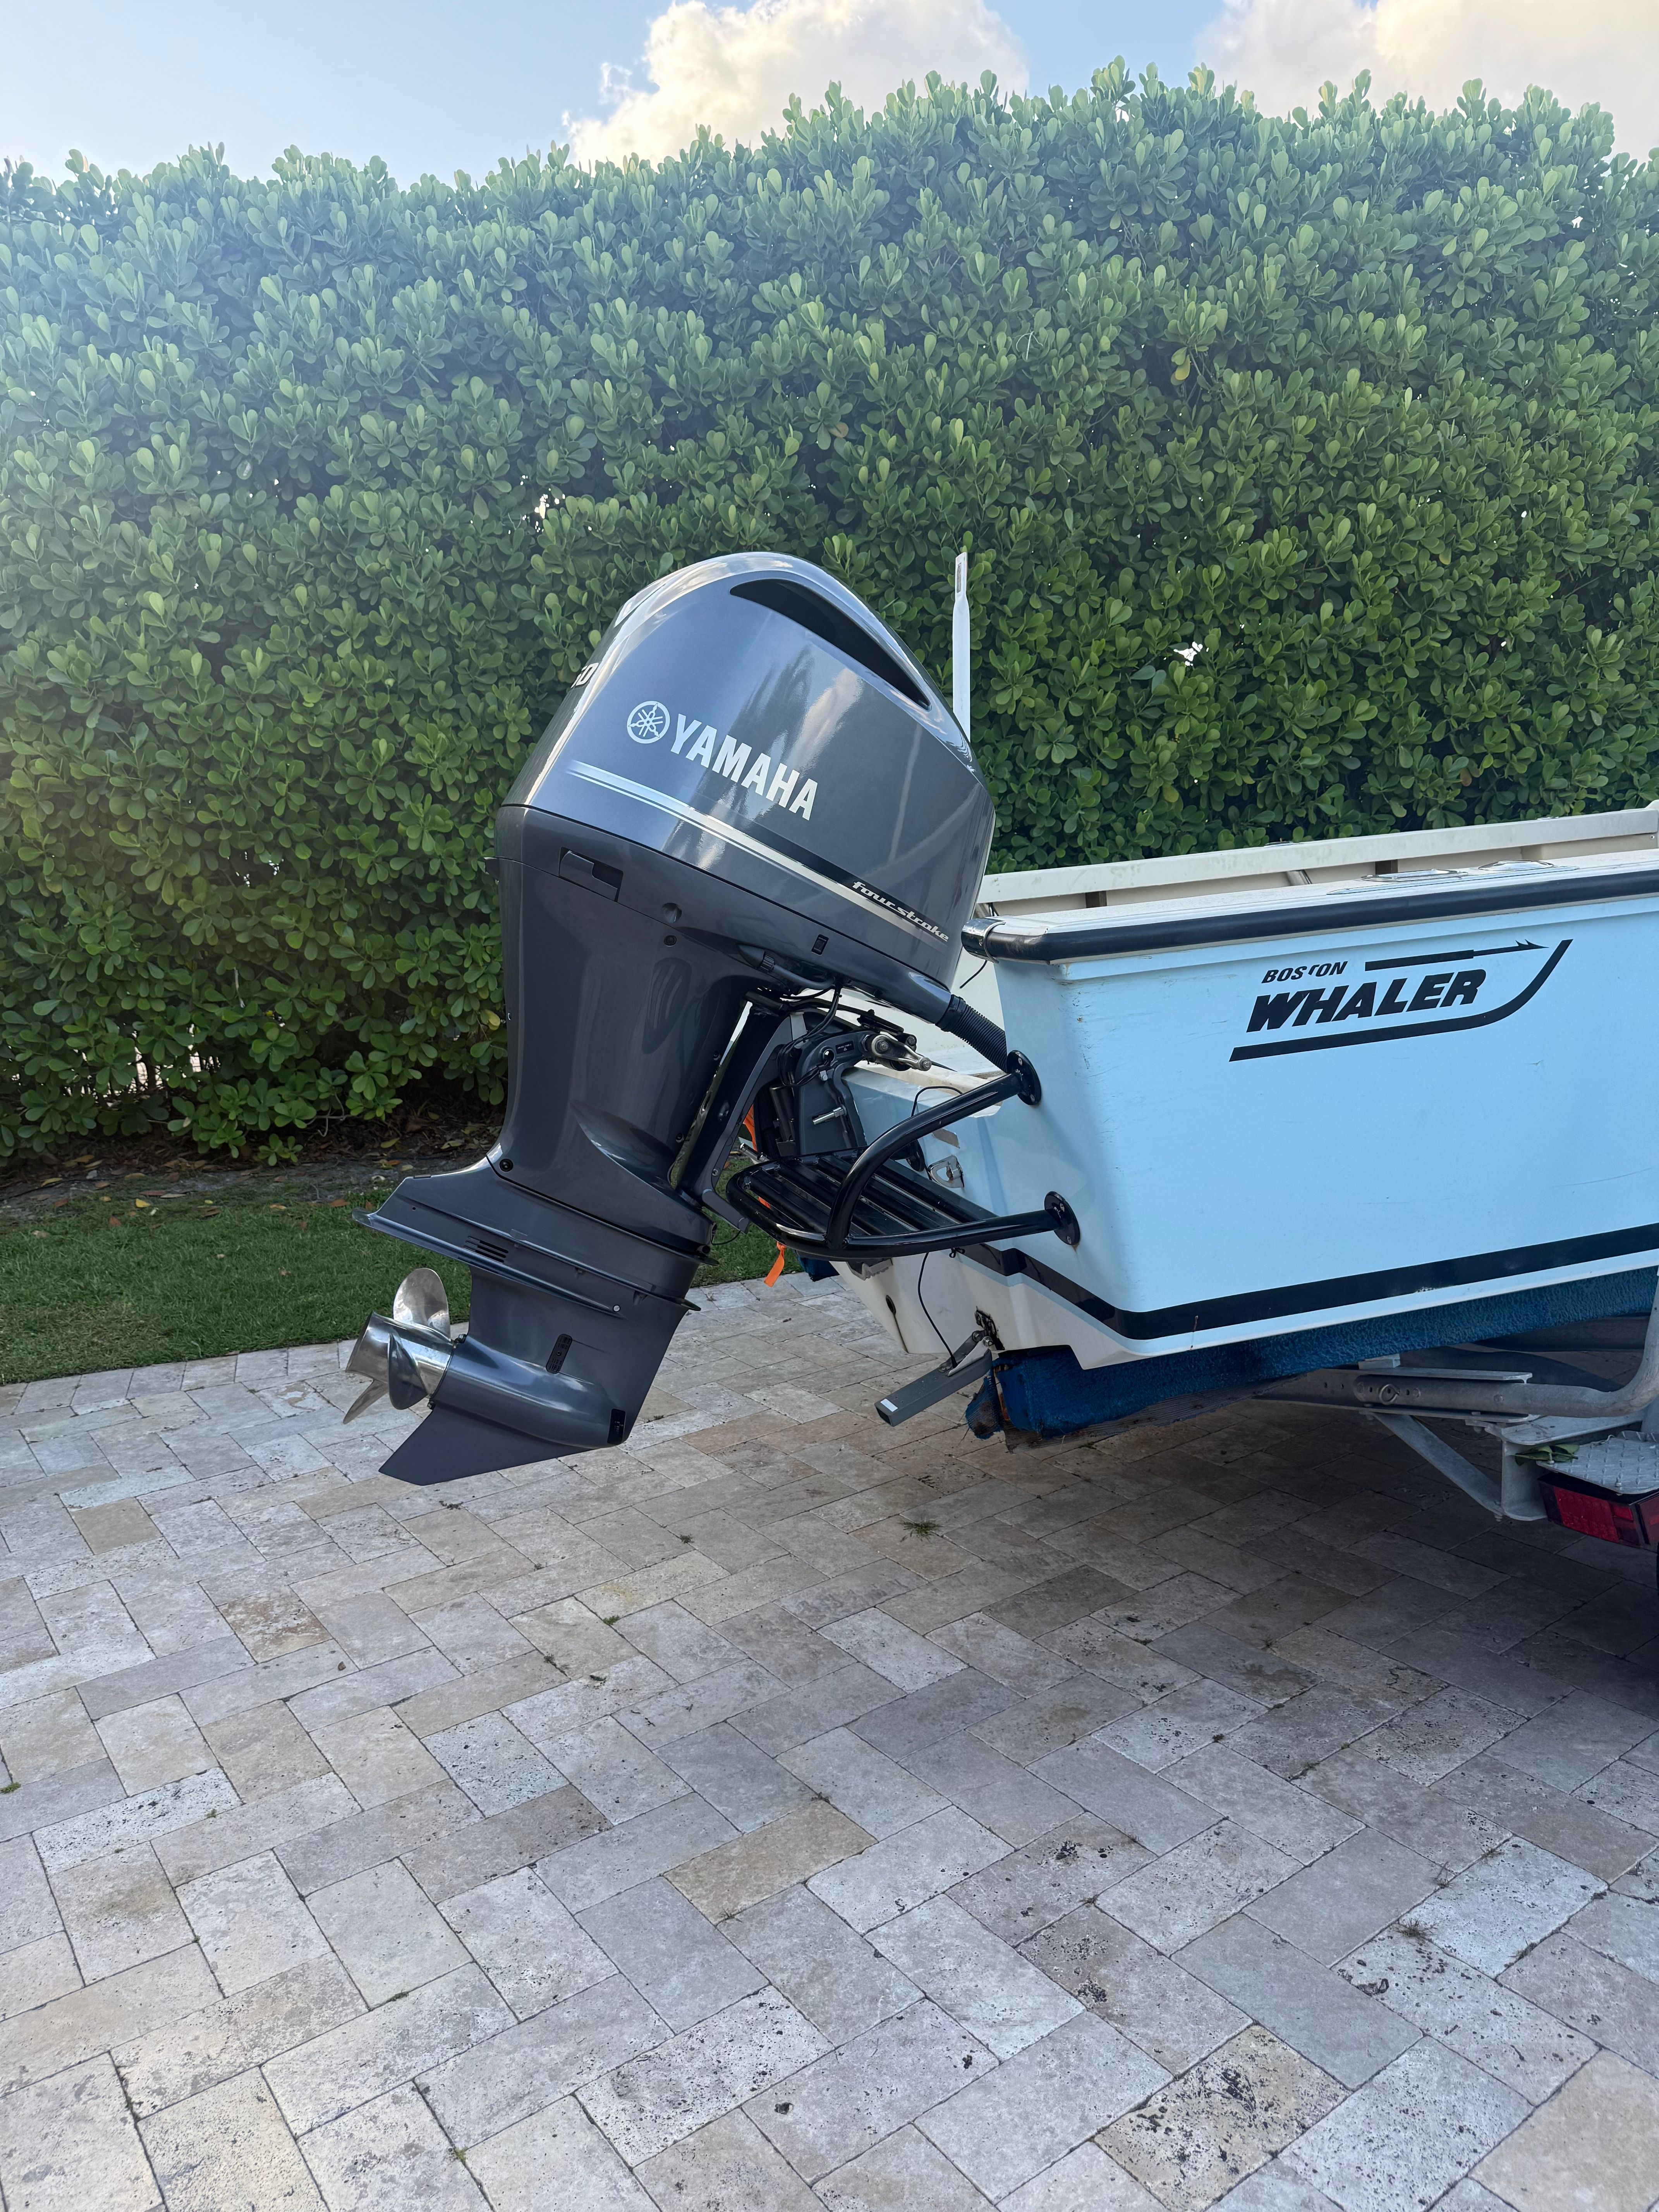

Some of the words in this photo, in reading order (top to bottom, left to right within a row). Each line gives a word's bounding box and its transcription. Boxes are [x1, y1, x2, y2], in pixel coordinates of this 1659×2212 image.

[671, 714, 817, 821] YAMAHA
[1246, 969, 1486, 1033] WHALER
[1261, 961, 1348, 984] BOSTON
